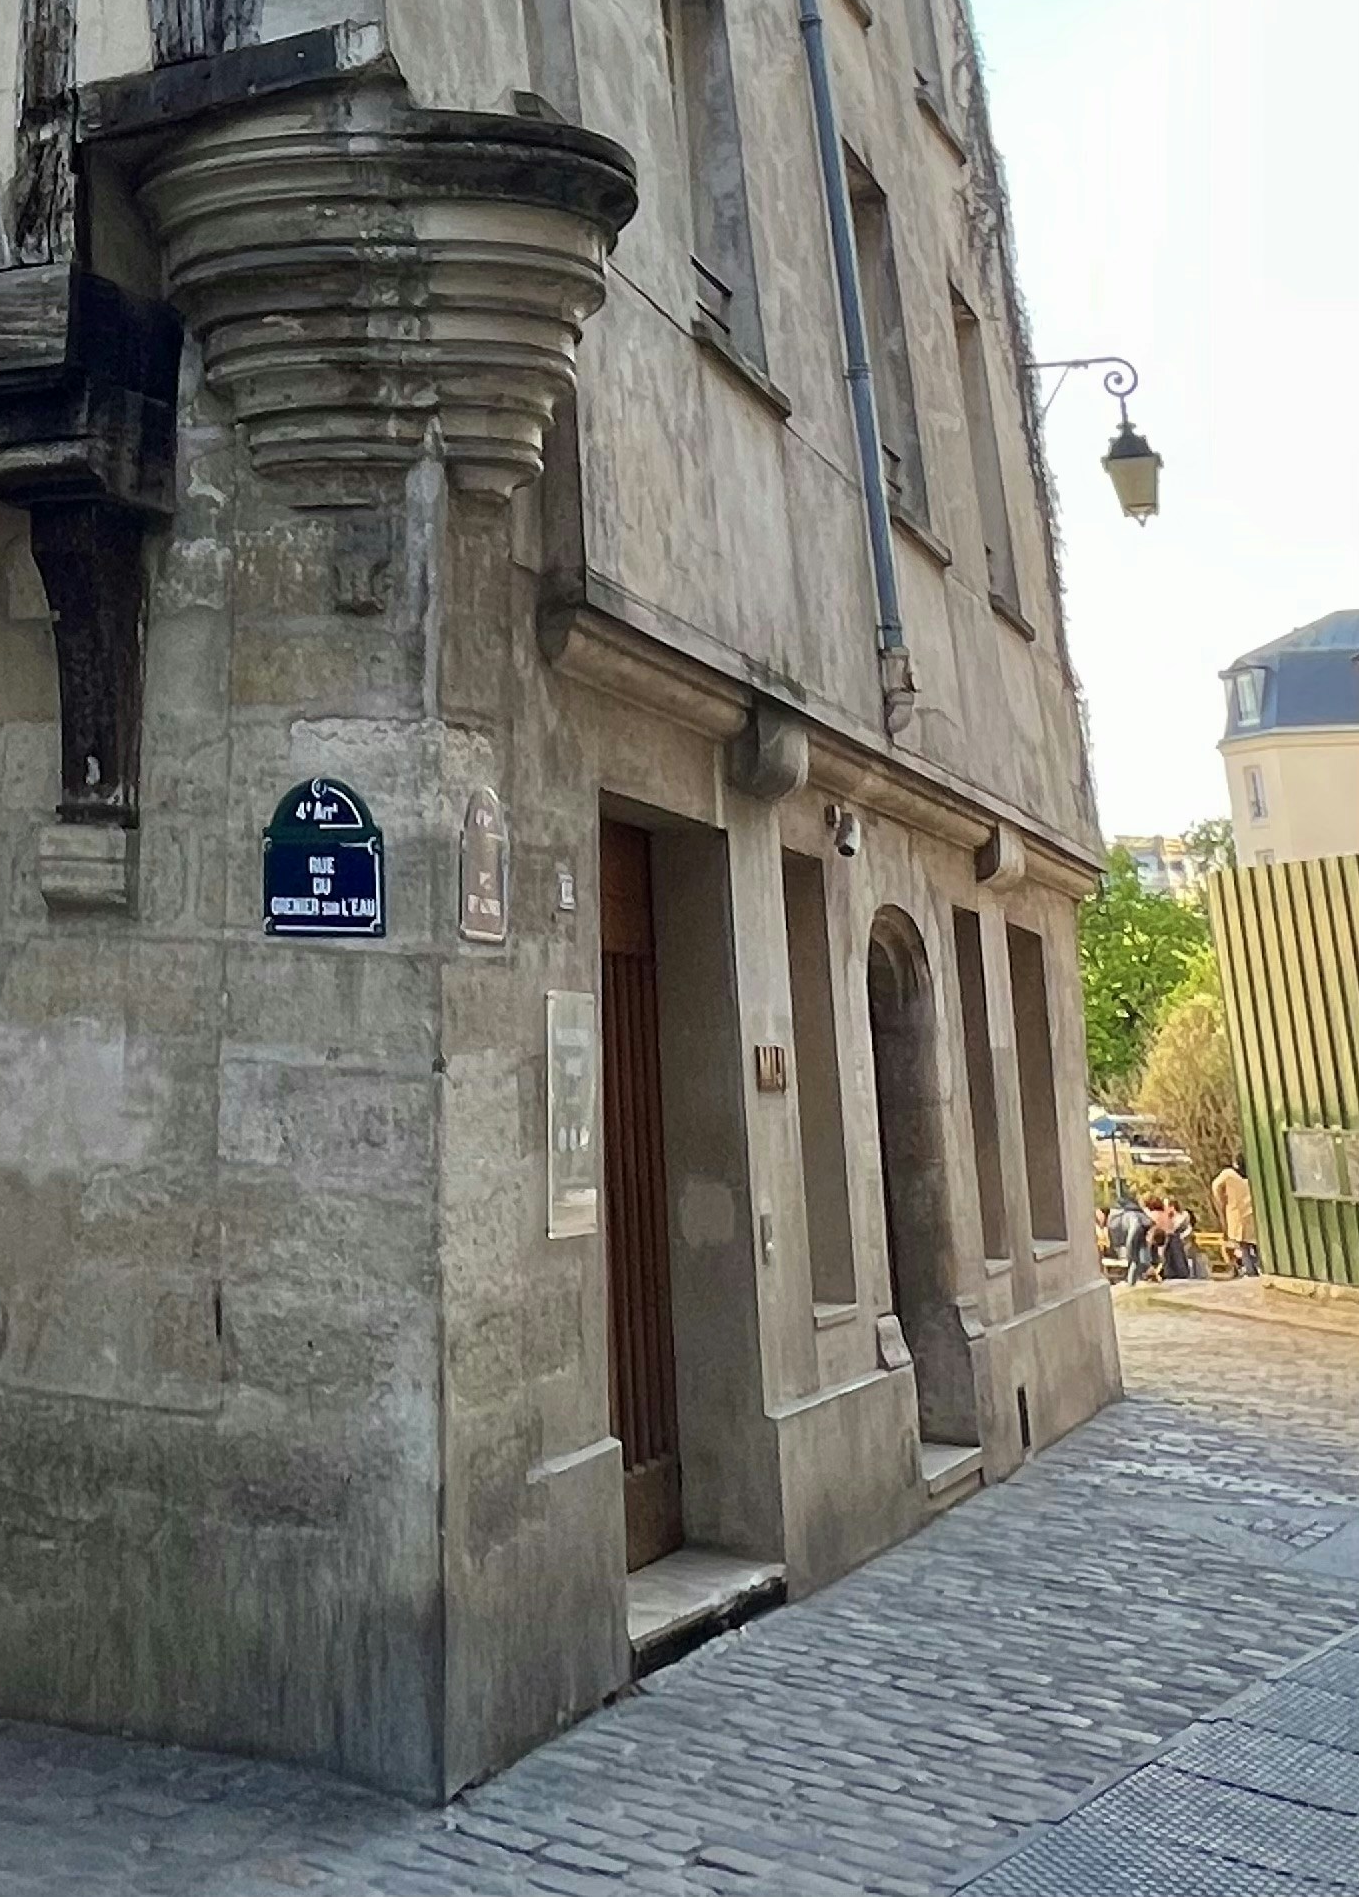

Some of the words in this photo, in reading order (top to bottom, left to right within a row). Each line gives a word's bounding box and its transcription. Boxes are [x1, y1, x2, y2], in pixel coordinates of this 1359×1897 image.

[308, 856, 336, 875] RUE
[312, 877, 332, 896] DU
[341, 897, 376, 917] L'EAU
